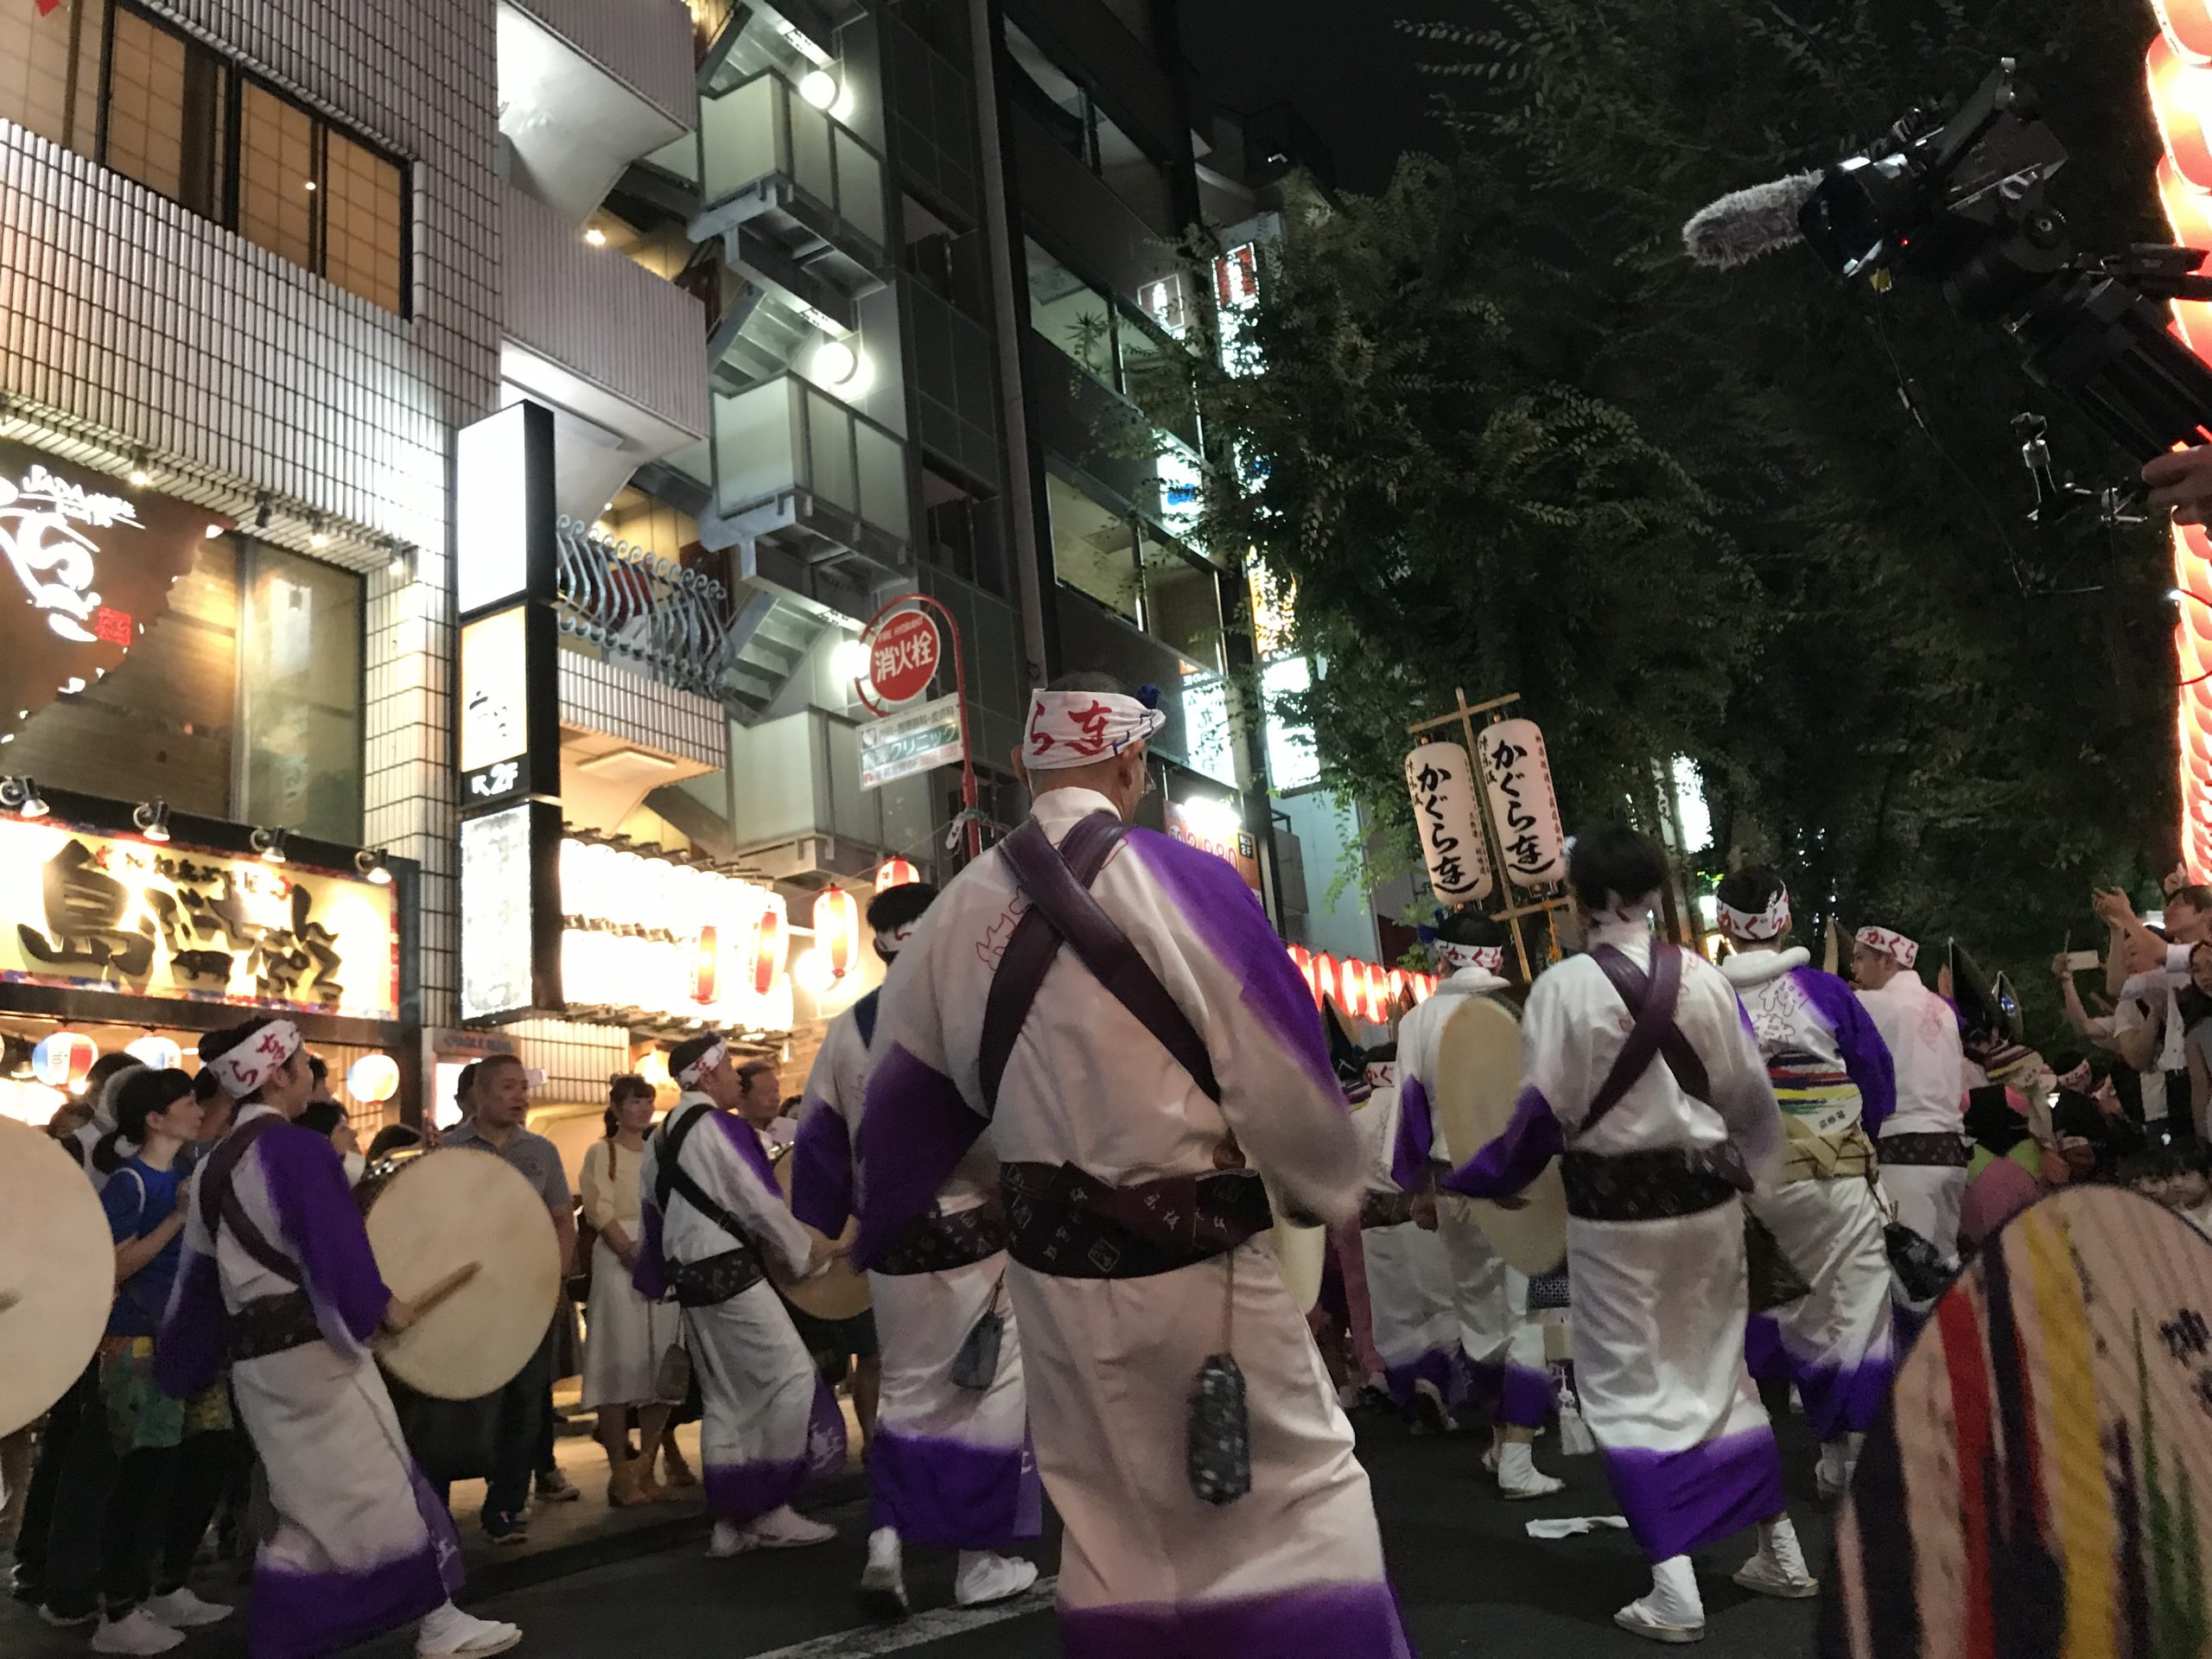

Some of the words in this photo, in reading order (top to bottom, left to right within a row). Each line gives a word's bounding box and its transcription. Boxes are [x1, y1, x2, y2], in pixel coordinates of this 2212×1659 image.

[874, 630, 934, 683] 消火栓
[878, 630, 893, 643] FIRE
[894, 616, 924, 639] HYDRANT
[1416, 762, 1479, 894] かぐら連
[1491, 740, 1555, 874] かぐら連
